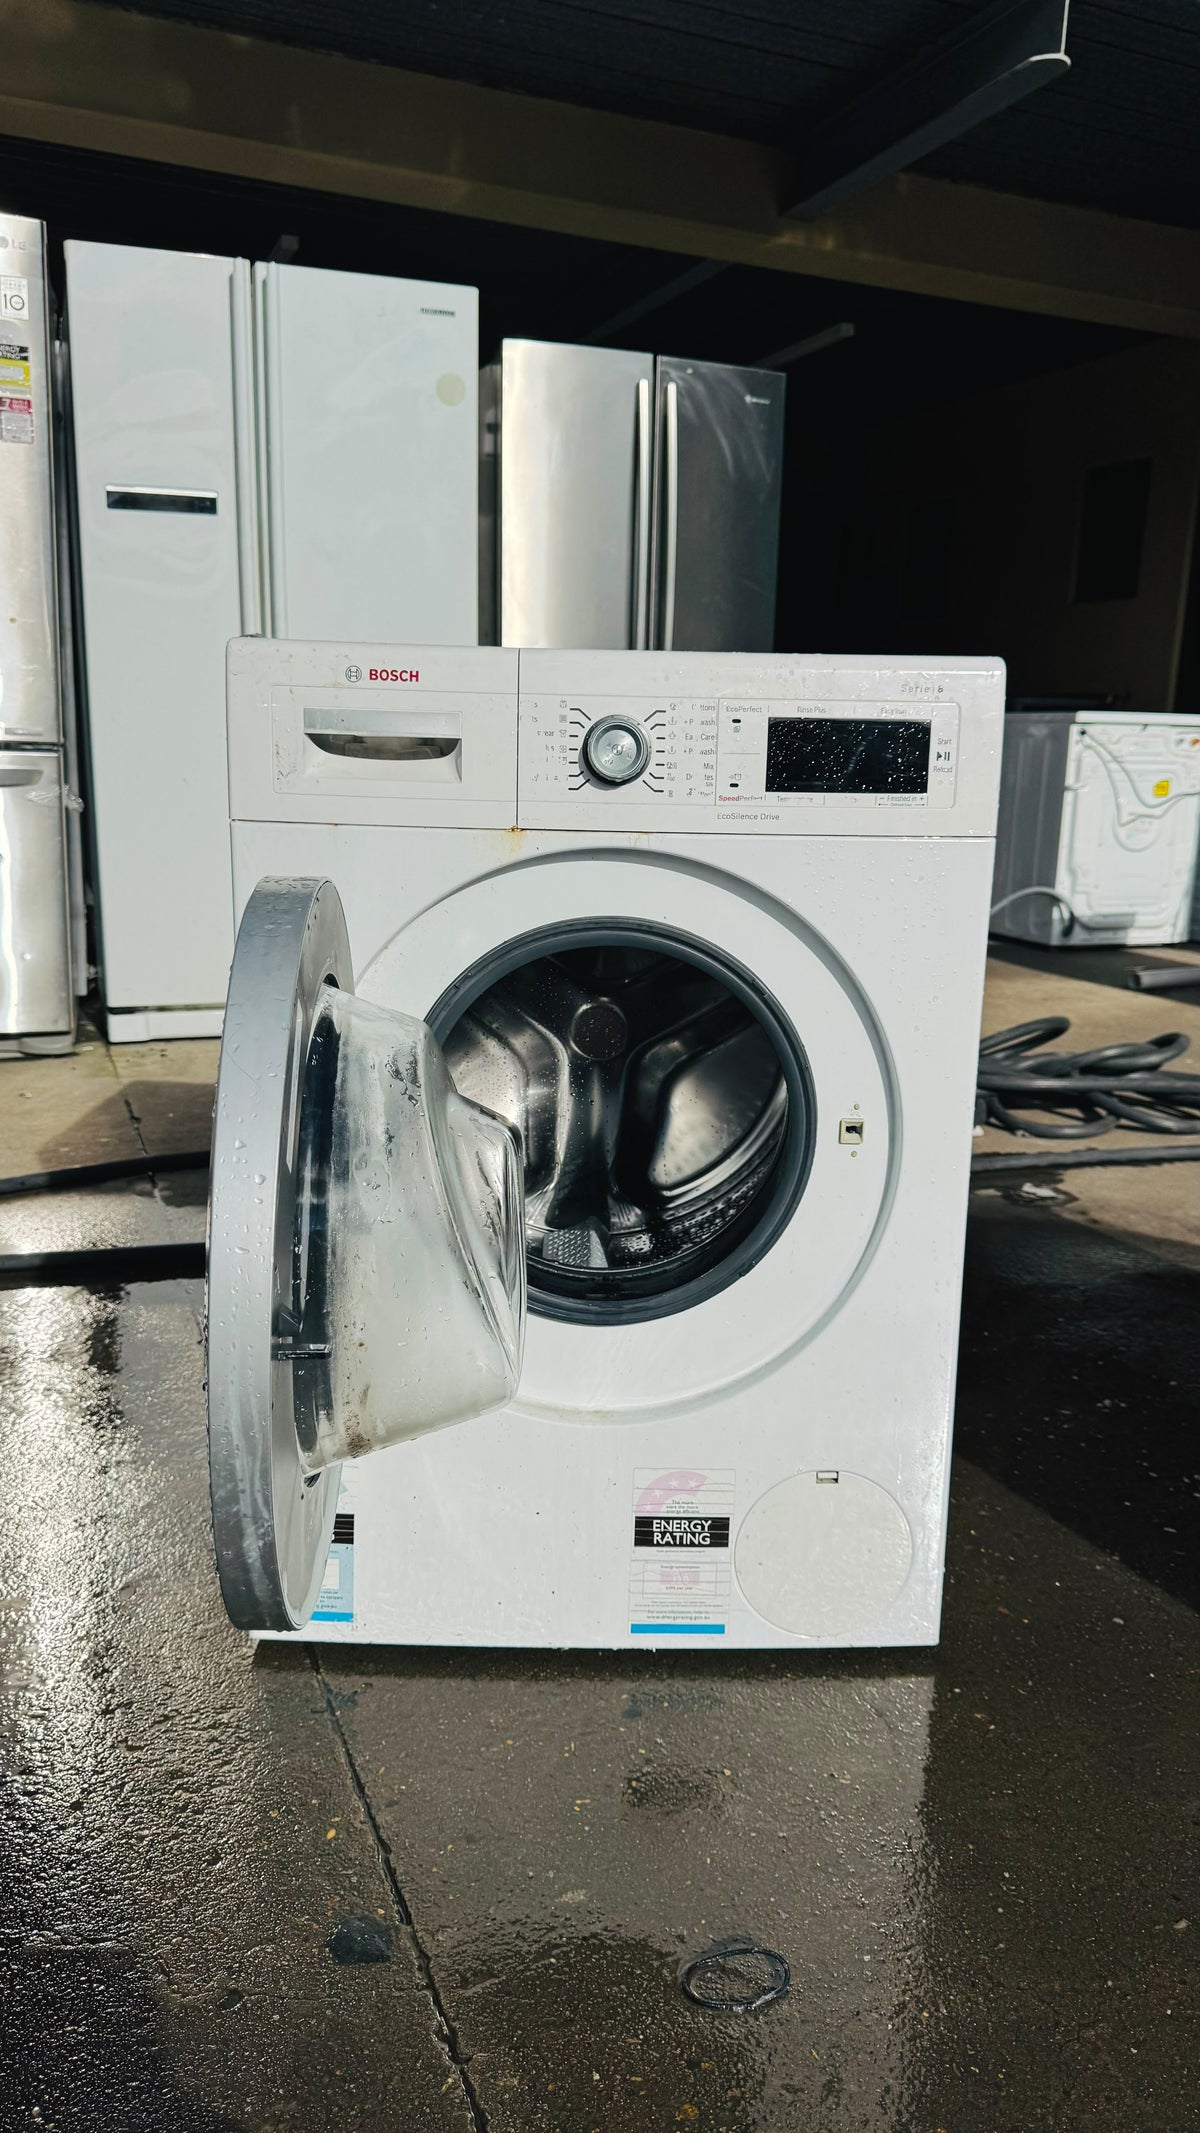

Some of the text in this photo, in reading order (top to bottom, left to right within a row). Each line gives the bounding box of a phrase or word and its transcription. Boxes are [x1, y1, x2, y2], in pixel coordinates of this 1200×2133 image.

[369, 668, 419, 682] BOSCH
[901, 684, 944, 693] Serie 6
[725, 705, 763, 713] EcoPerfect
[689, 718, 716, 726] Pwash
[700, 733, 716, 741] Care
[688, 747, 715, 756] Pwash
[718, 794, 763, 802] SpeedPerfect
[717, 812, 758, 820] EcoSilence
[652, 1520, 712, 1532] ENERGY
[653, 1532, 711, 1545] RATING
